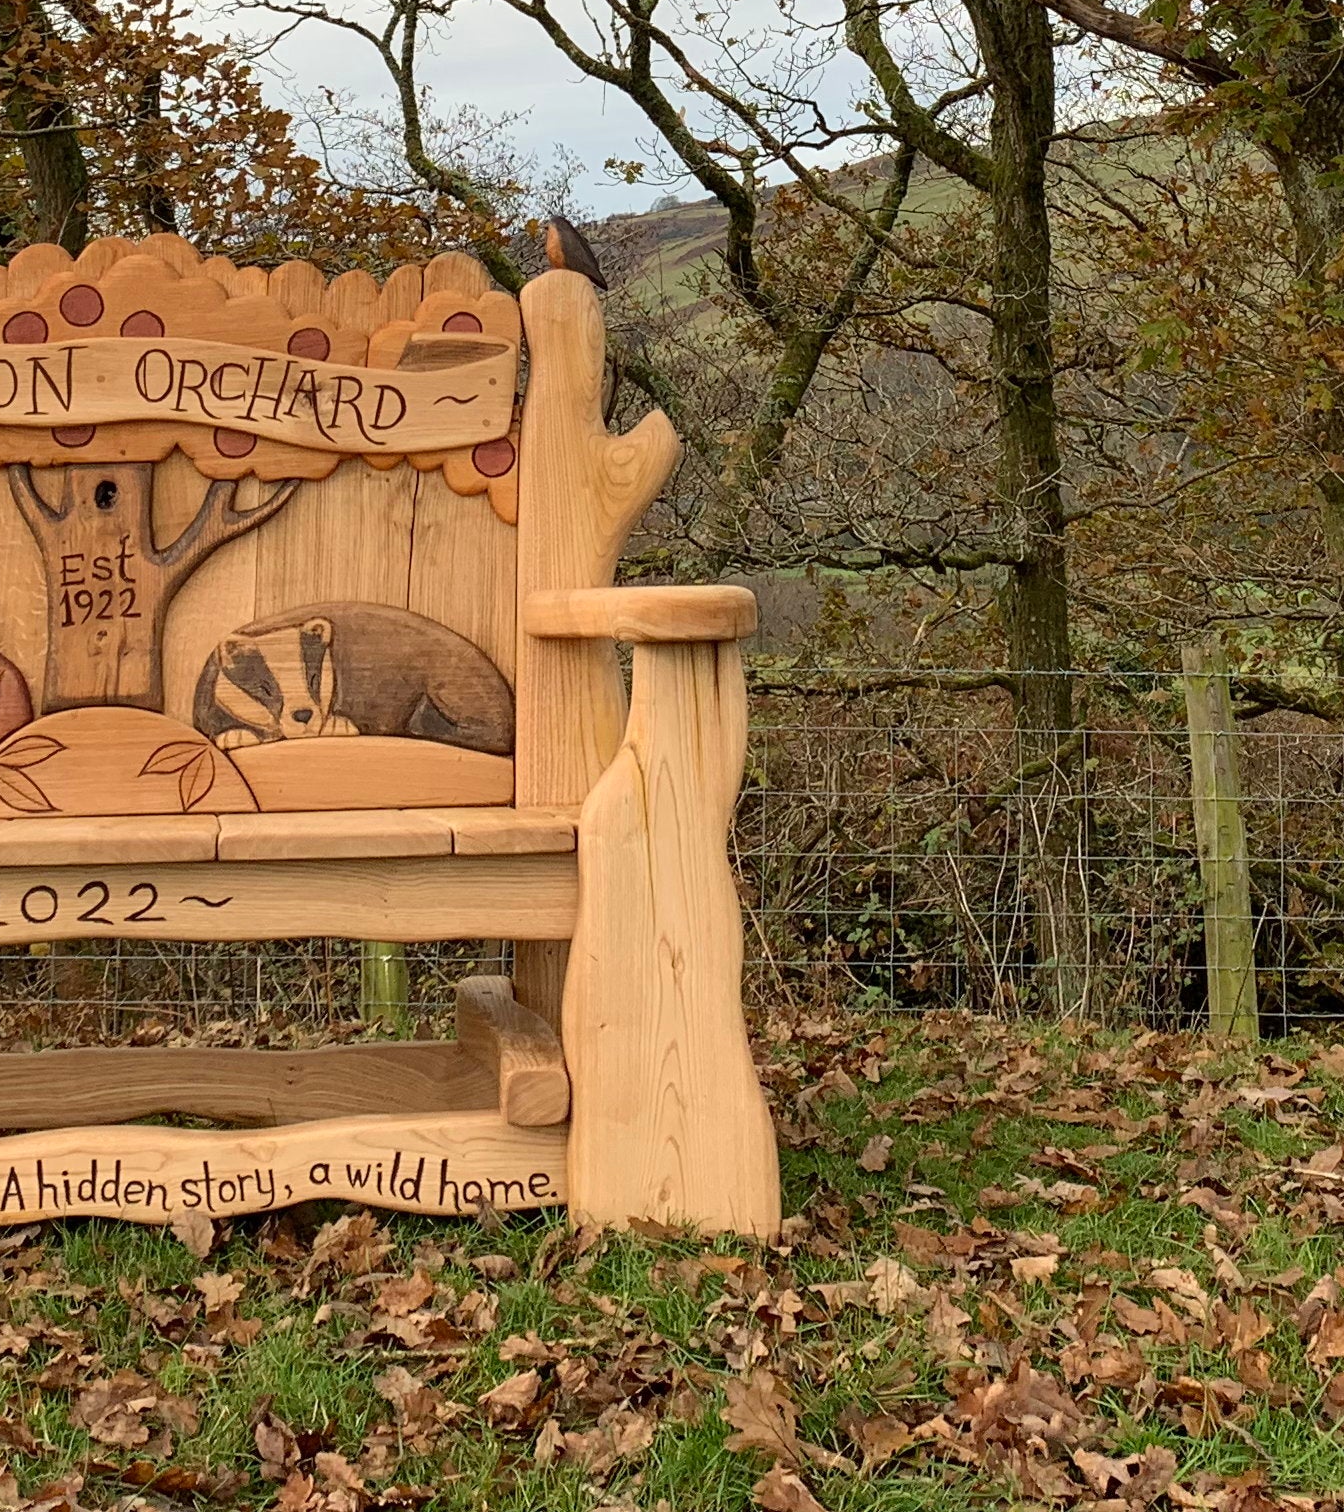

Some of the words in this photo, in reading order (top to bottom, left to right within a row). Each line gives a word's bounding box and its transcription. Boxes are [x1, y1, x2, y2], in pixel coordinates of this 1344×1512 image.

[134, 348, 408, 445] ORCHARD
[59, 534, 136, 587] Est
[59, 588, 142, 628] 1922
[0, 1166, 27, 1212] A
[36, 1158, 174, 1212] hidden
[181, 1161, 294, 1212] story,
[308, 1161, 334, 1187] a
[346, 1151, 426, 1206] wild
[440, 1158, 560, 1212] home.
